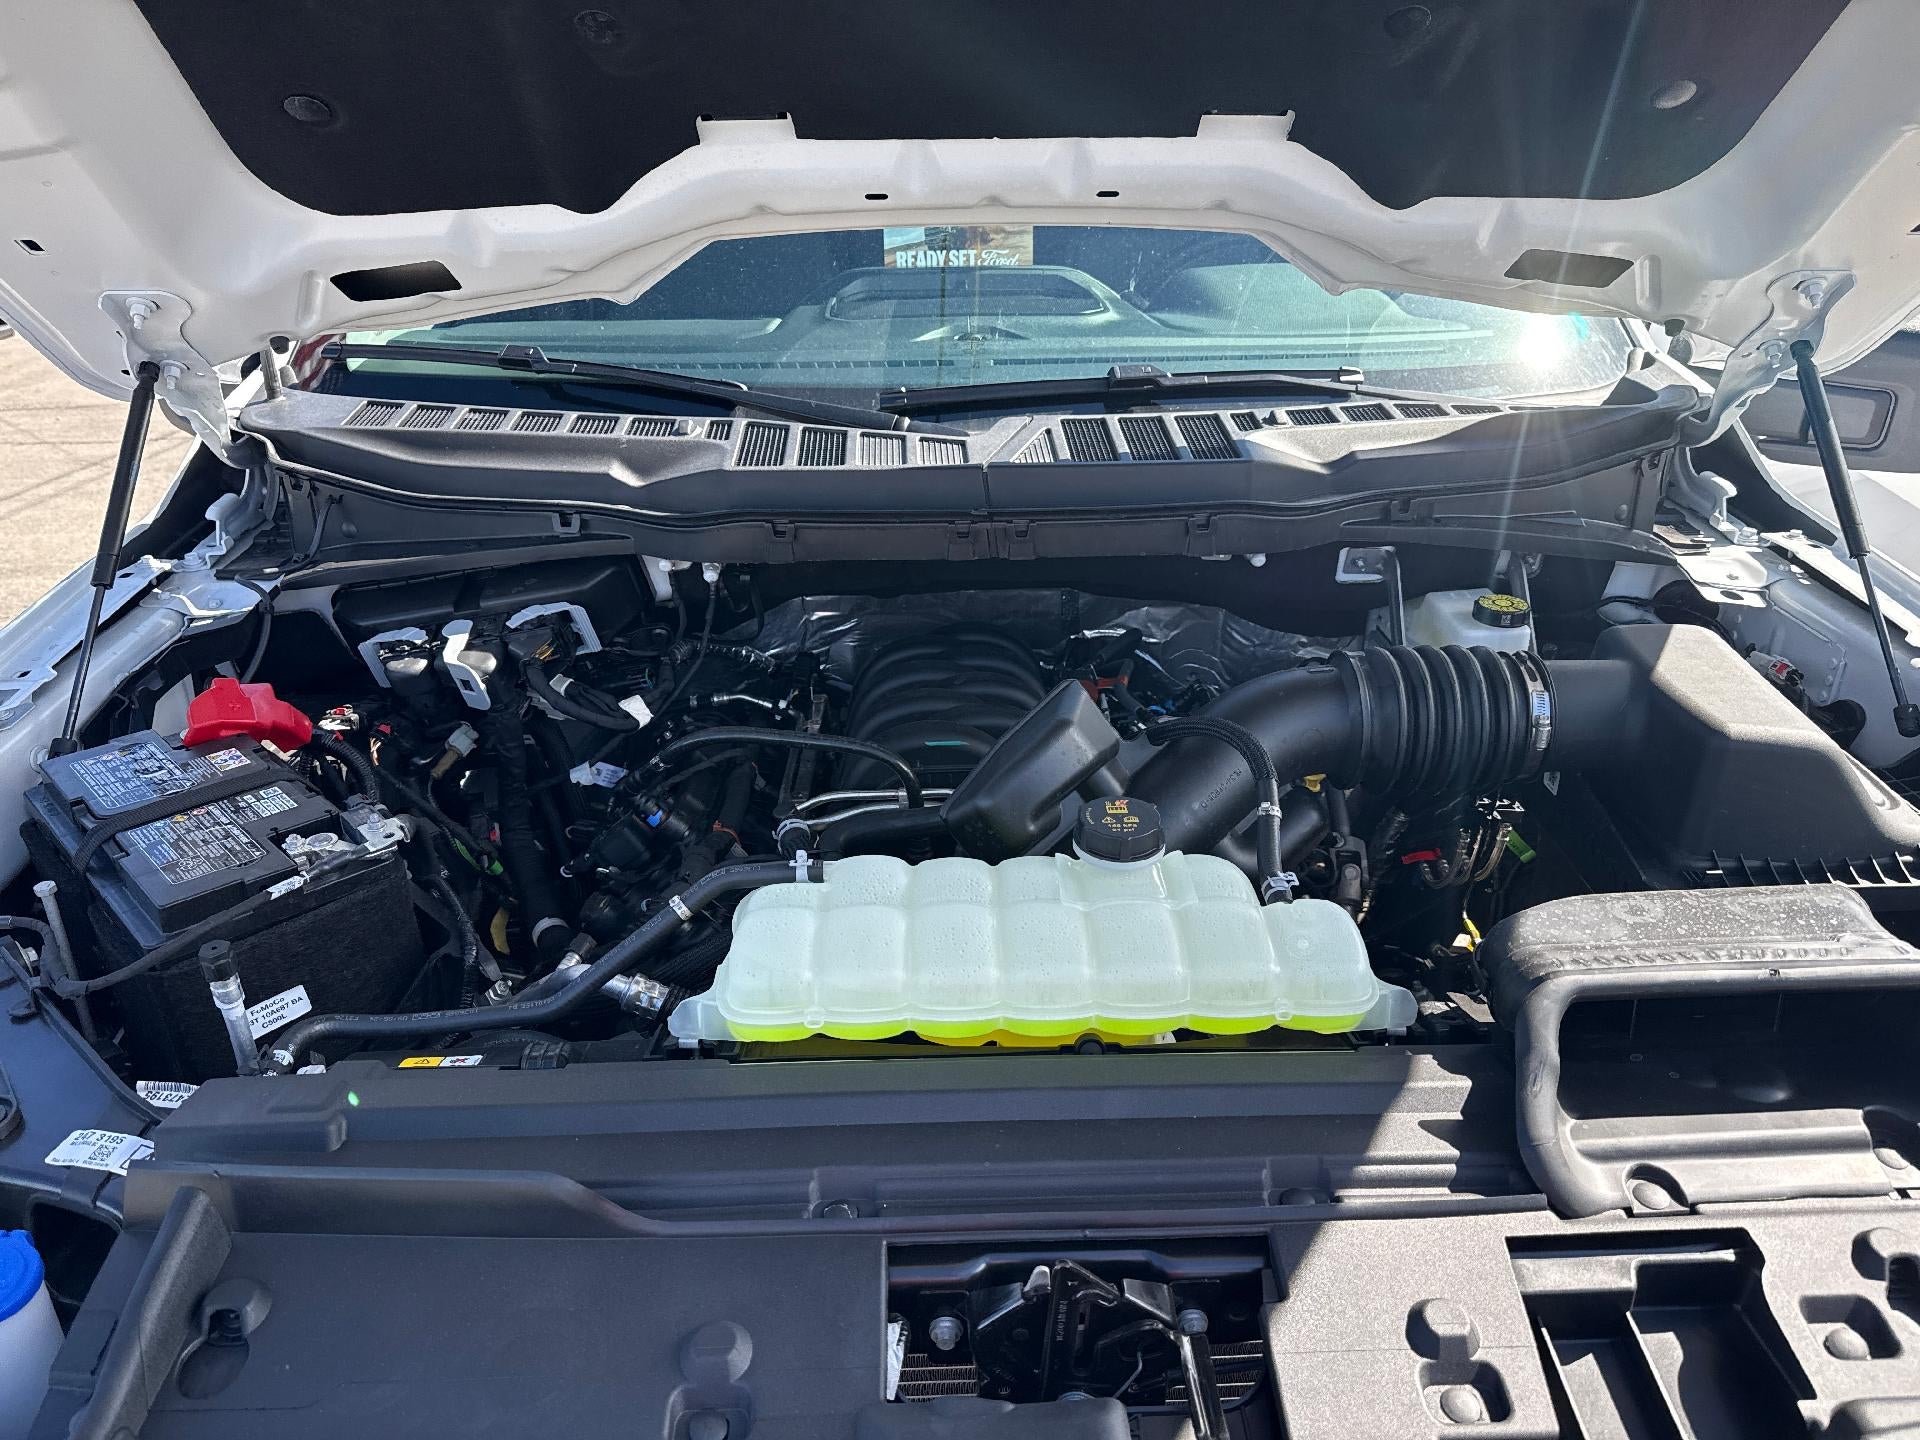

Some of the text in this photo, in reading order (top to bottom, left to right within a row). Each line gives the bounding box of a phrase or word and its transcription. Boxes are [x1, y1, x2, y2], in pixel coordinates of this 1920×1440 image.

[896, 248, 1020, 268] READY SET Ford
[250, 996, 285, 1017] FoMoCo
[145, 1089, 186, 1104] 473195
[96, 1132, 127, 1146] 3195
